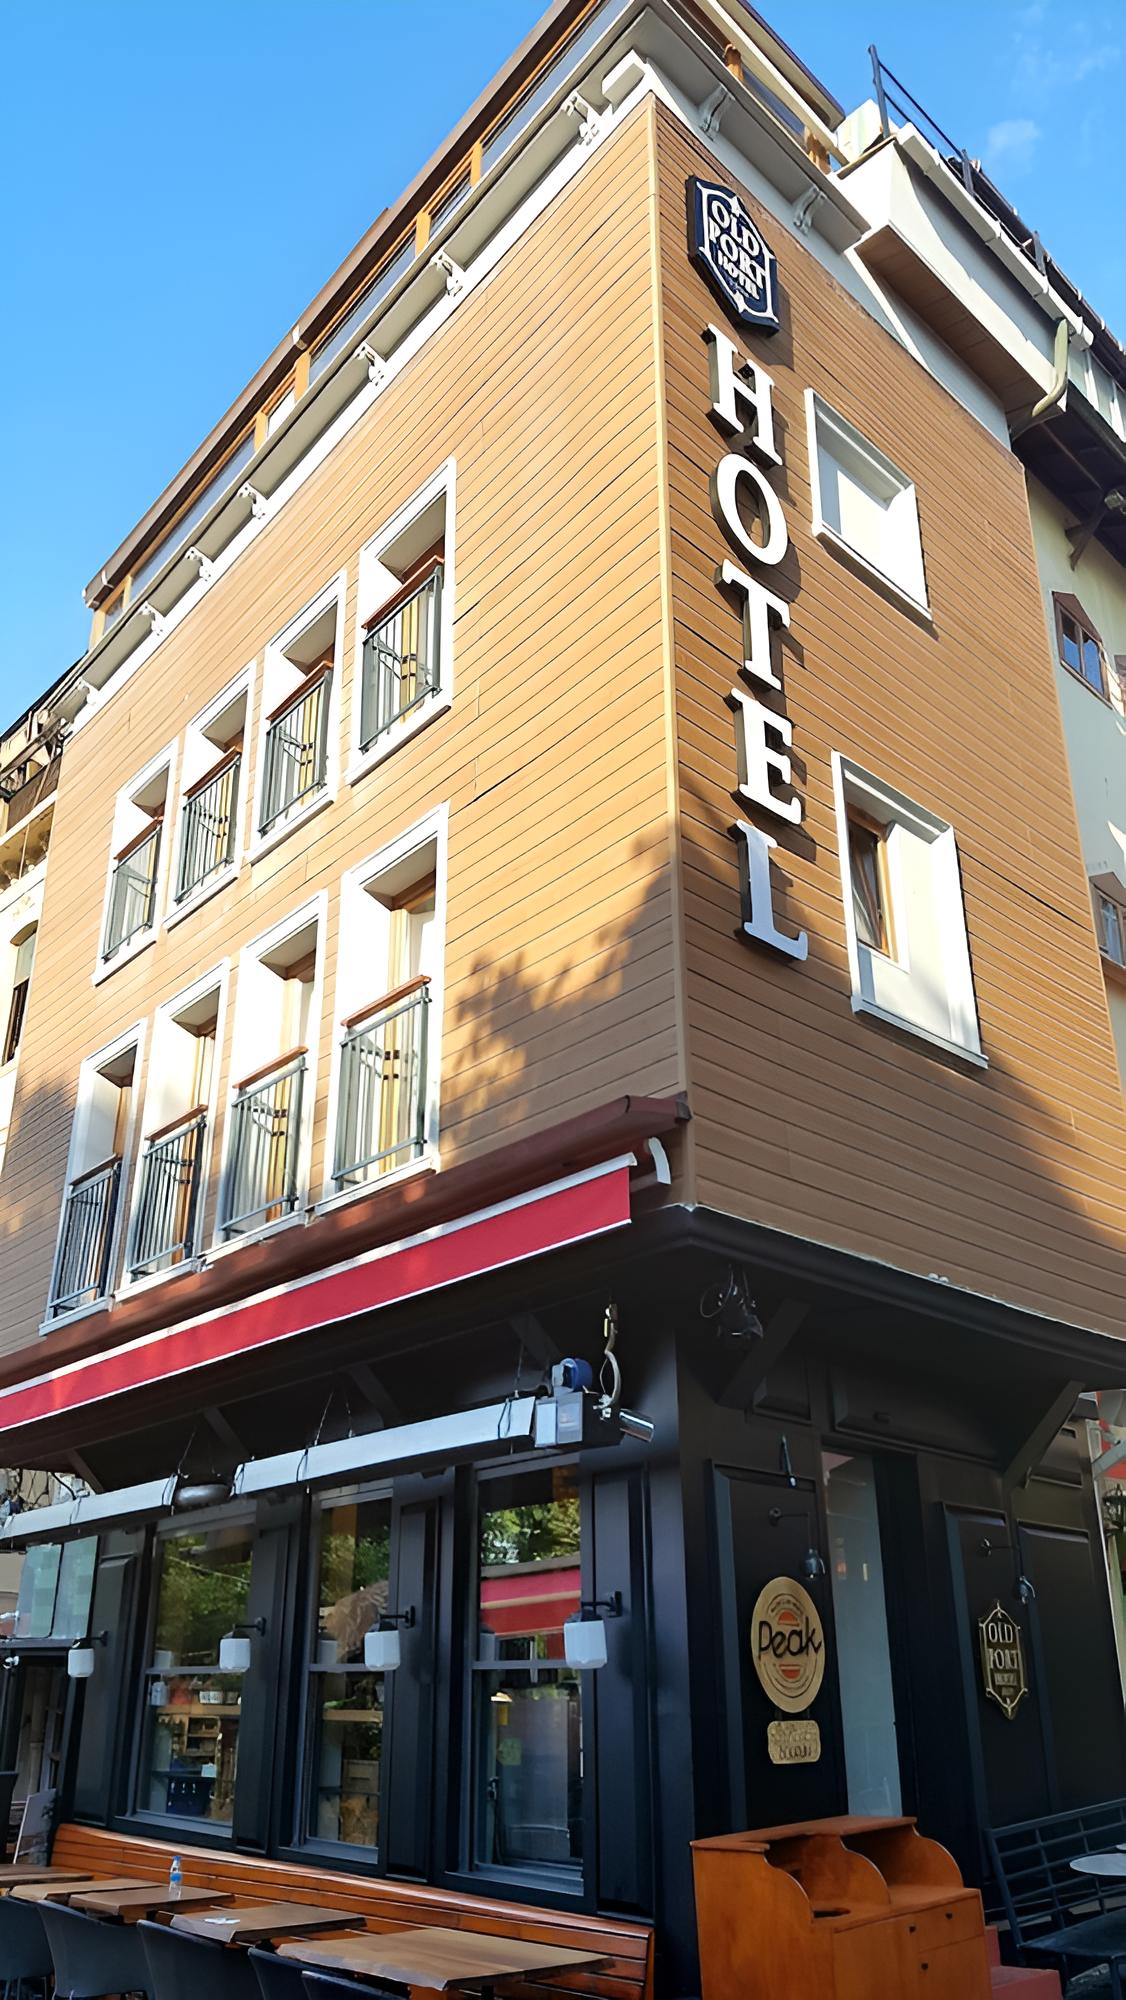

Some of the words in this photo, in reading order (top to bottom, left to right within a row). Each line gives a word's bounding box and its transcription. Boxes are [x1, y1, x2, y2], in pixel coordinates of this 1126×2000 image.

[709, 216, 766, 289] PORT
[711, 200, 760, 257] OLD
[718, 249, 760, 300] HOTEL
[707, 322, 809, 962] HOTEL
[758, 1616, 823, 1661] Peak
[988, 1621, 1013, 1643] OLD
